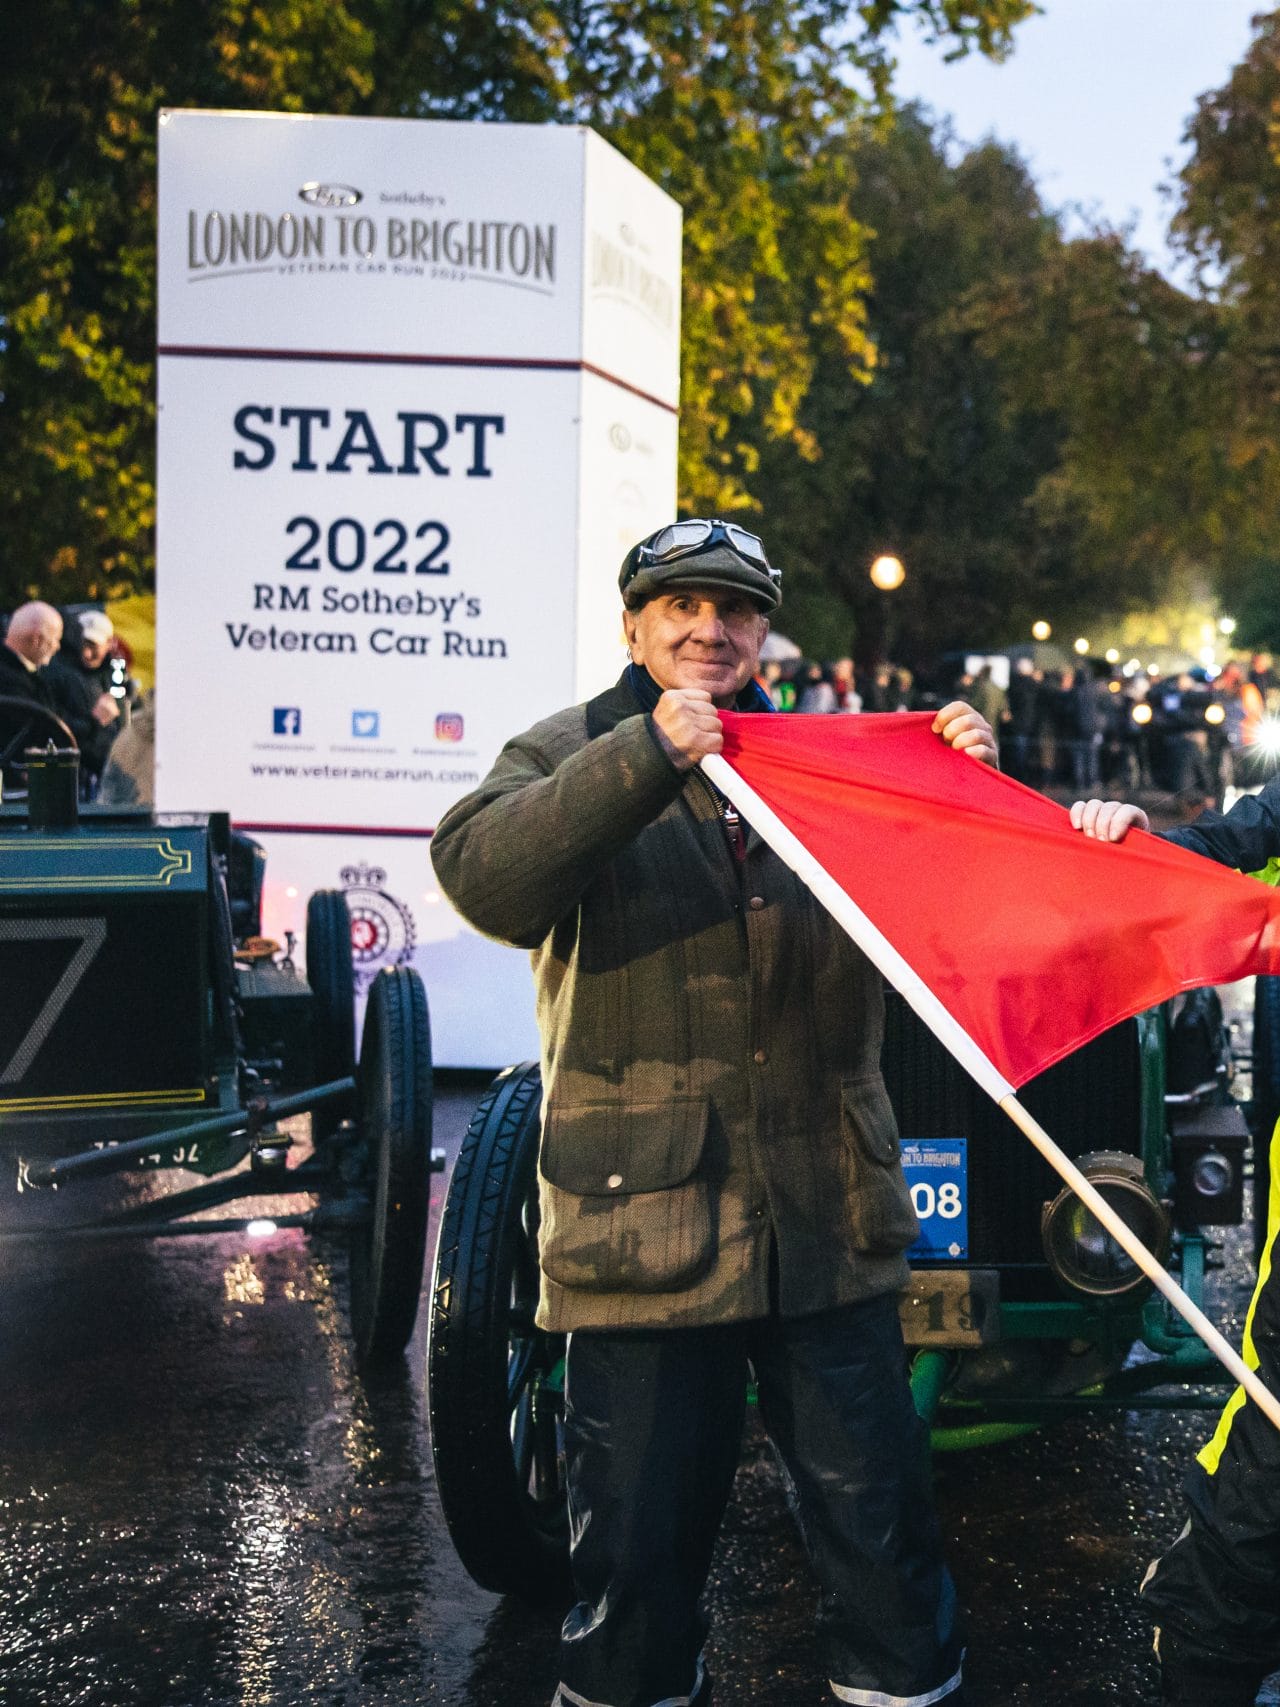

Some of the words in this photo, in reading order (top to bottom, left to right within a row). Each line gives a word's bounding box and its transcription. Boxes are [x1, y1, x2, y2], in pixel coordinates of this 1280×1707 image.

[188, 209, 325, 269] LONDON
[335, 215, 377, 259] TO
[387, 217, 556, 282] BRIGHTON
[278, 263, 350, 274] VETERAN
[356, 263, 386, 274] CAR
[392, 264, 424, 276] RUN
[233, 404, 505, 478] START
[284, 515, 452, 576] 2022
[252, 584, 309, 612] RM
[322, 586, 481, 623] Sotheby's
[225, 623, 357, 654] Veteran
[369, 628, 429, 656] Car
[442, 632, 508, 659] Run
[251, 763, 479, 783] www.veterancarrun.com
[0, 918, 107, 1083] 7
